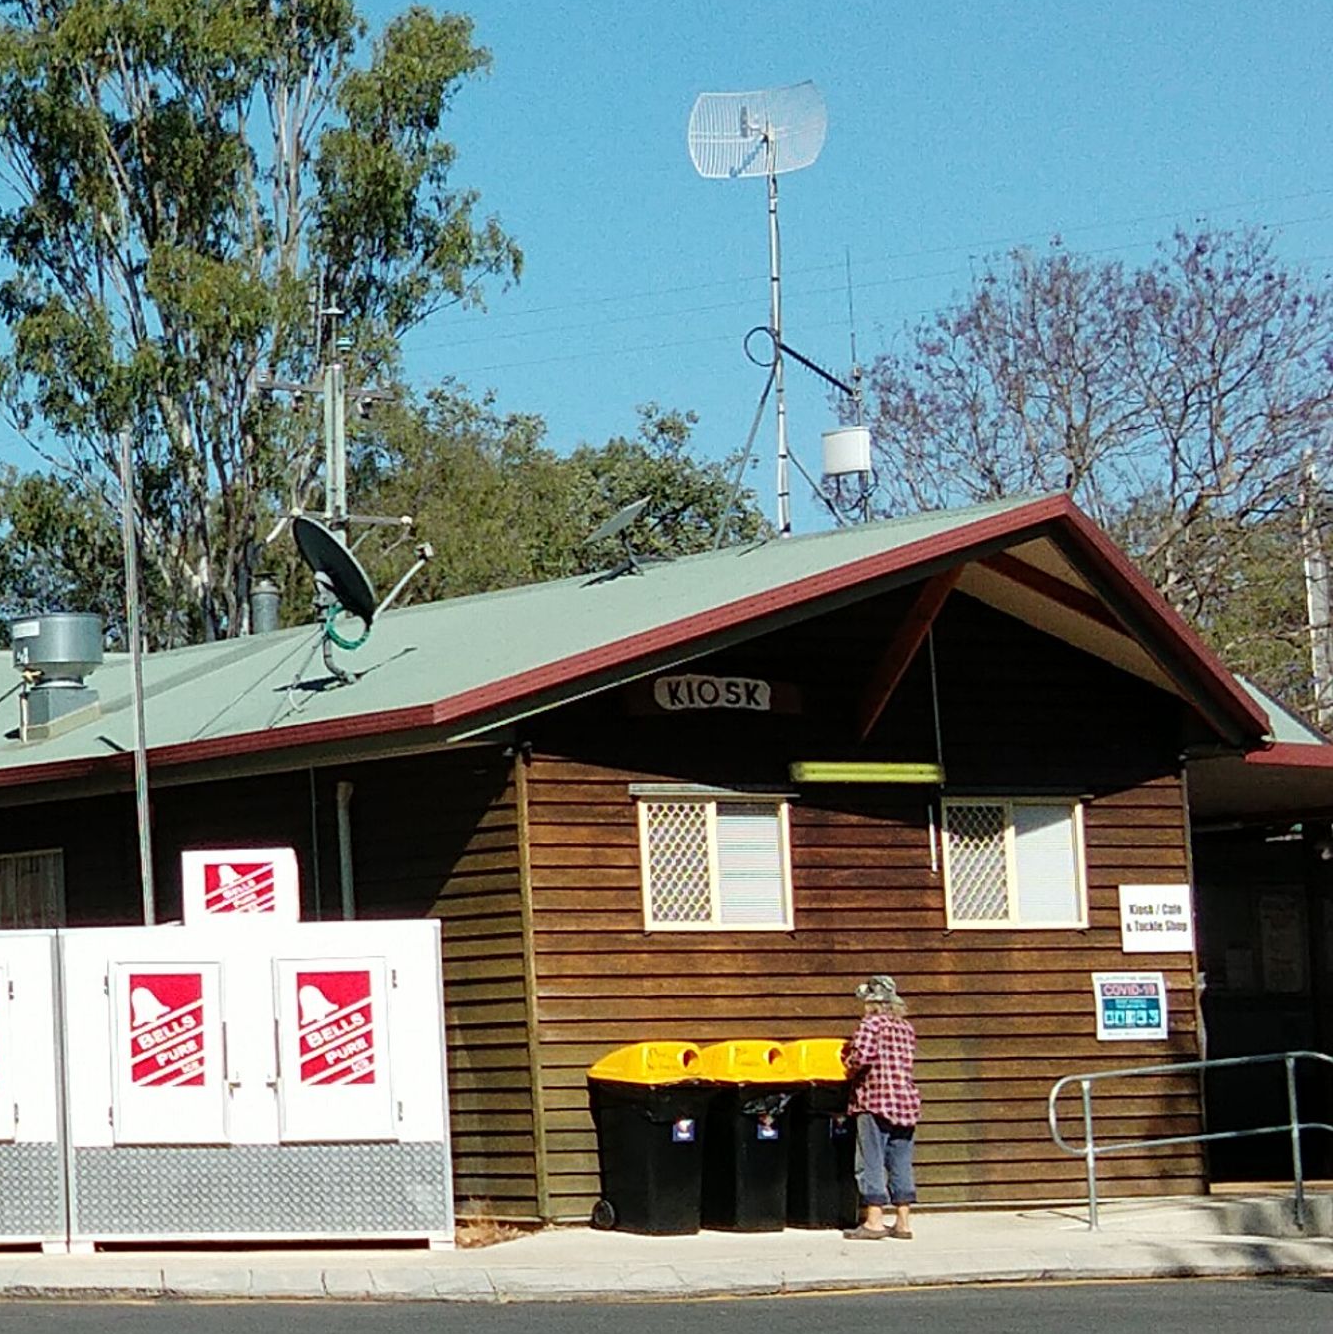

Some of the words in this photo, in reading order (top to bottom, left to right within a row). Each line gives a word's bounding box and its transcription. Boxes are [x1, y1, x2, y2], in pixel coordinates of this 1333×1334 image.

[666, 679, 762, 707] KIOSK
[1103, 983, 1156, 996] COVID-19
[136, 1014, 197, 1050] BELLS
[304, 1012, 366, 1049] BELLS
[155, 1039, 198, 1067] PURE
[324, 1037, 369, 1065] PURE
